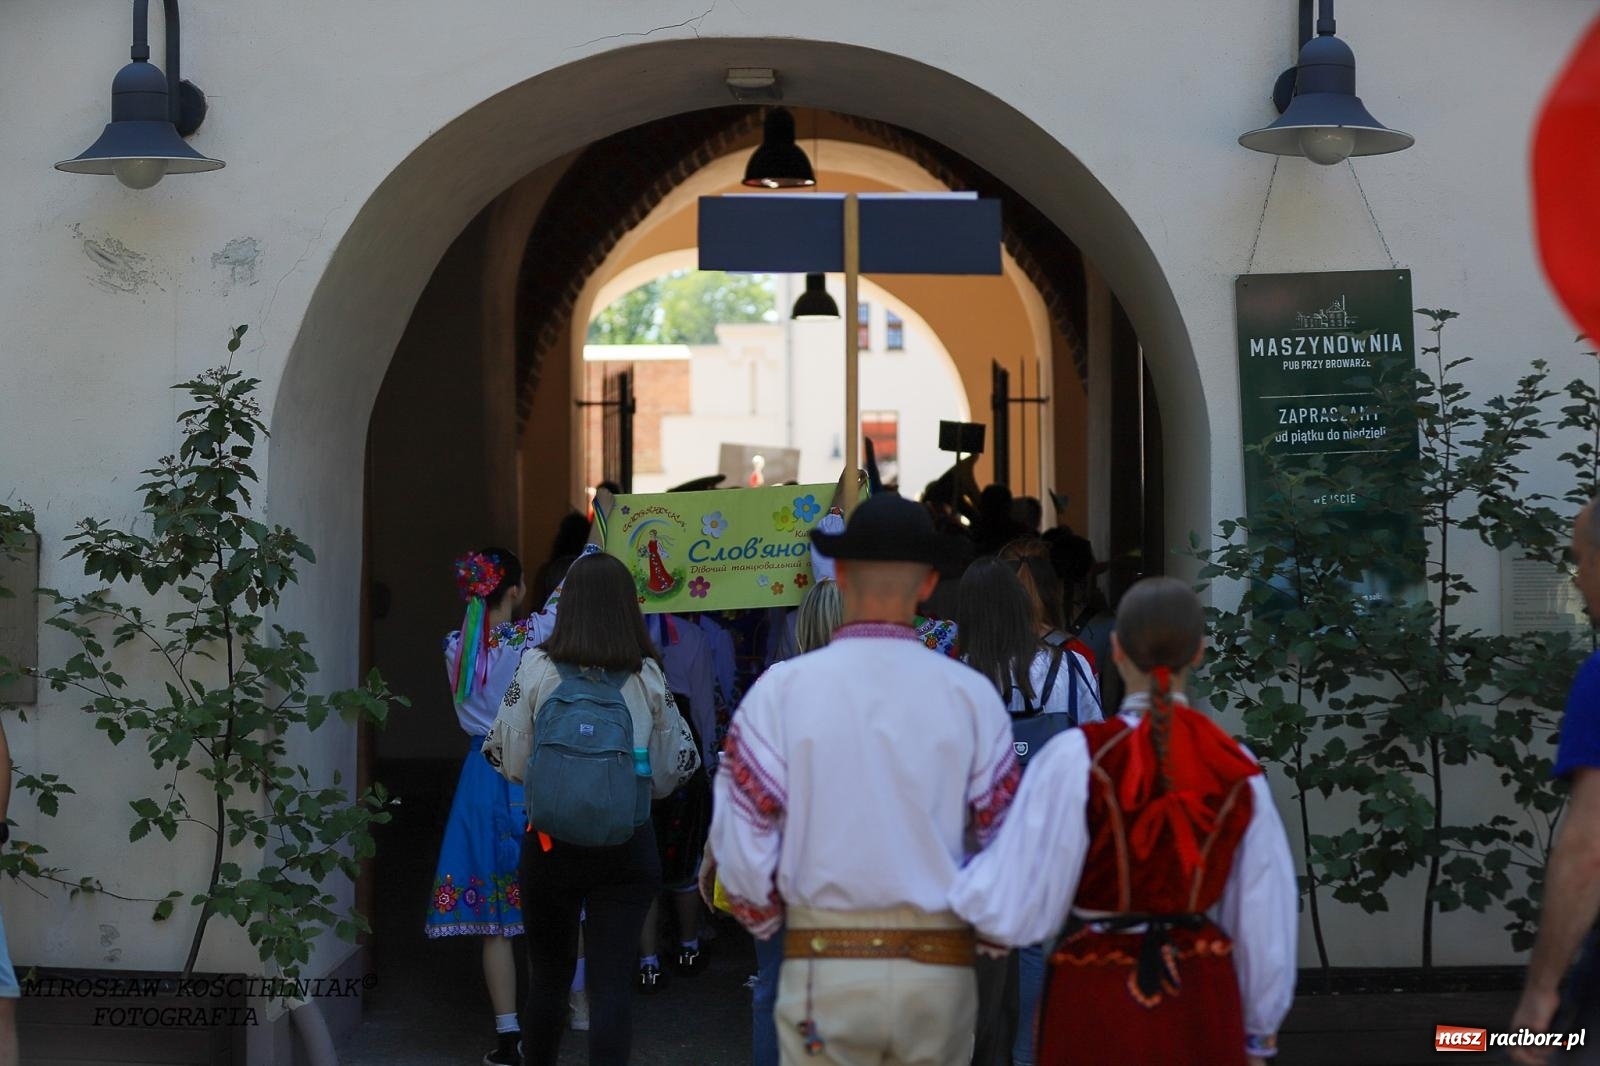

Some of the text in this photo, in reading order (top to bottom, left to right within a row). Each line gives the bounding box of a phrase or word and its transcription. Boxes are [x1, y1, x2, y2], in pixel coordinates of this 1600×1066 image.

[1250, 333, 1403, 357] MASZYNOWNIA
[1282, 360, 1300, 371] PUB
[1301, 359, 1323, 370] PRZY
[1275, 428, 1288, 443] od
[1291, 428, 1325, 445] piątku
[1327, 427, 1340, 441] do
